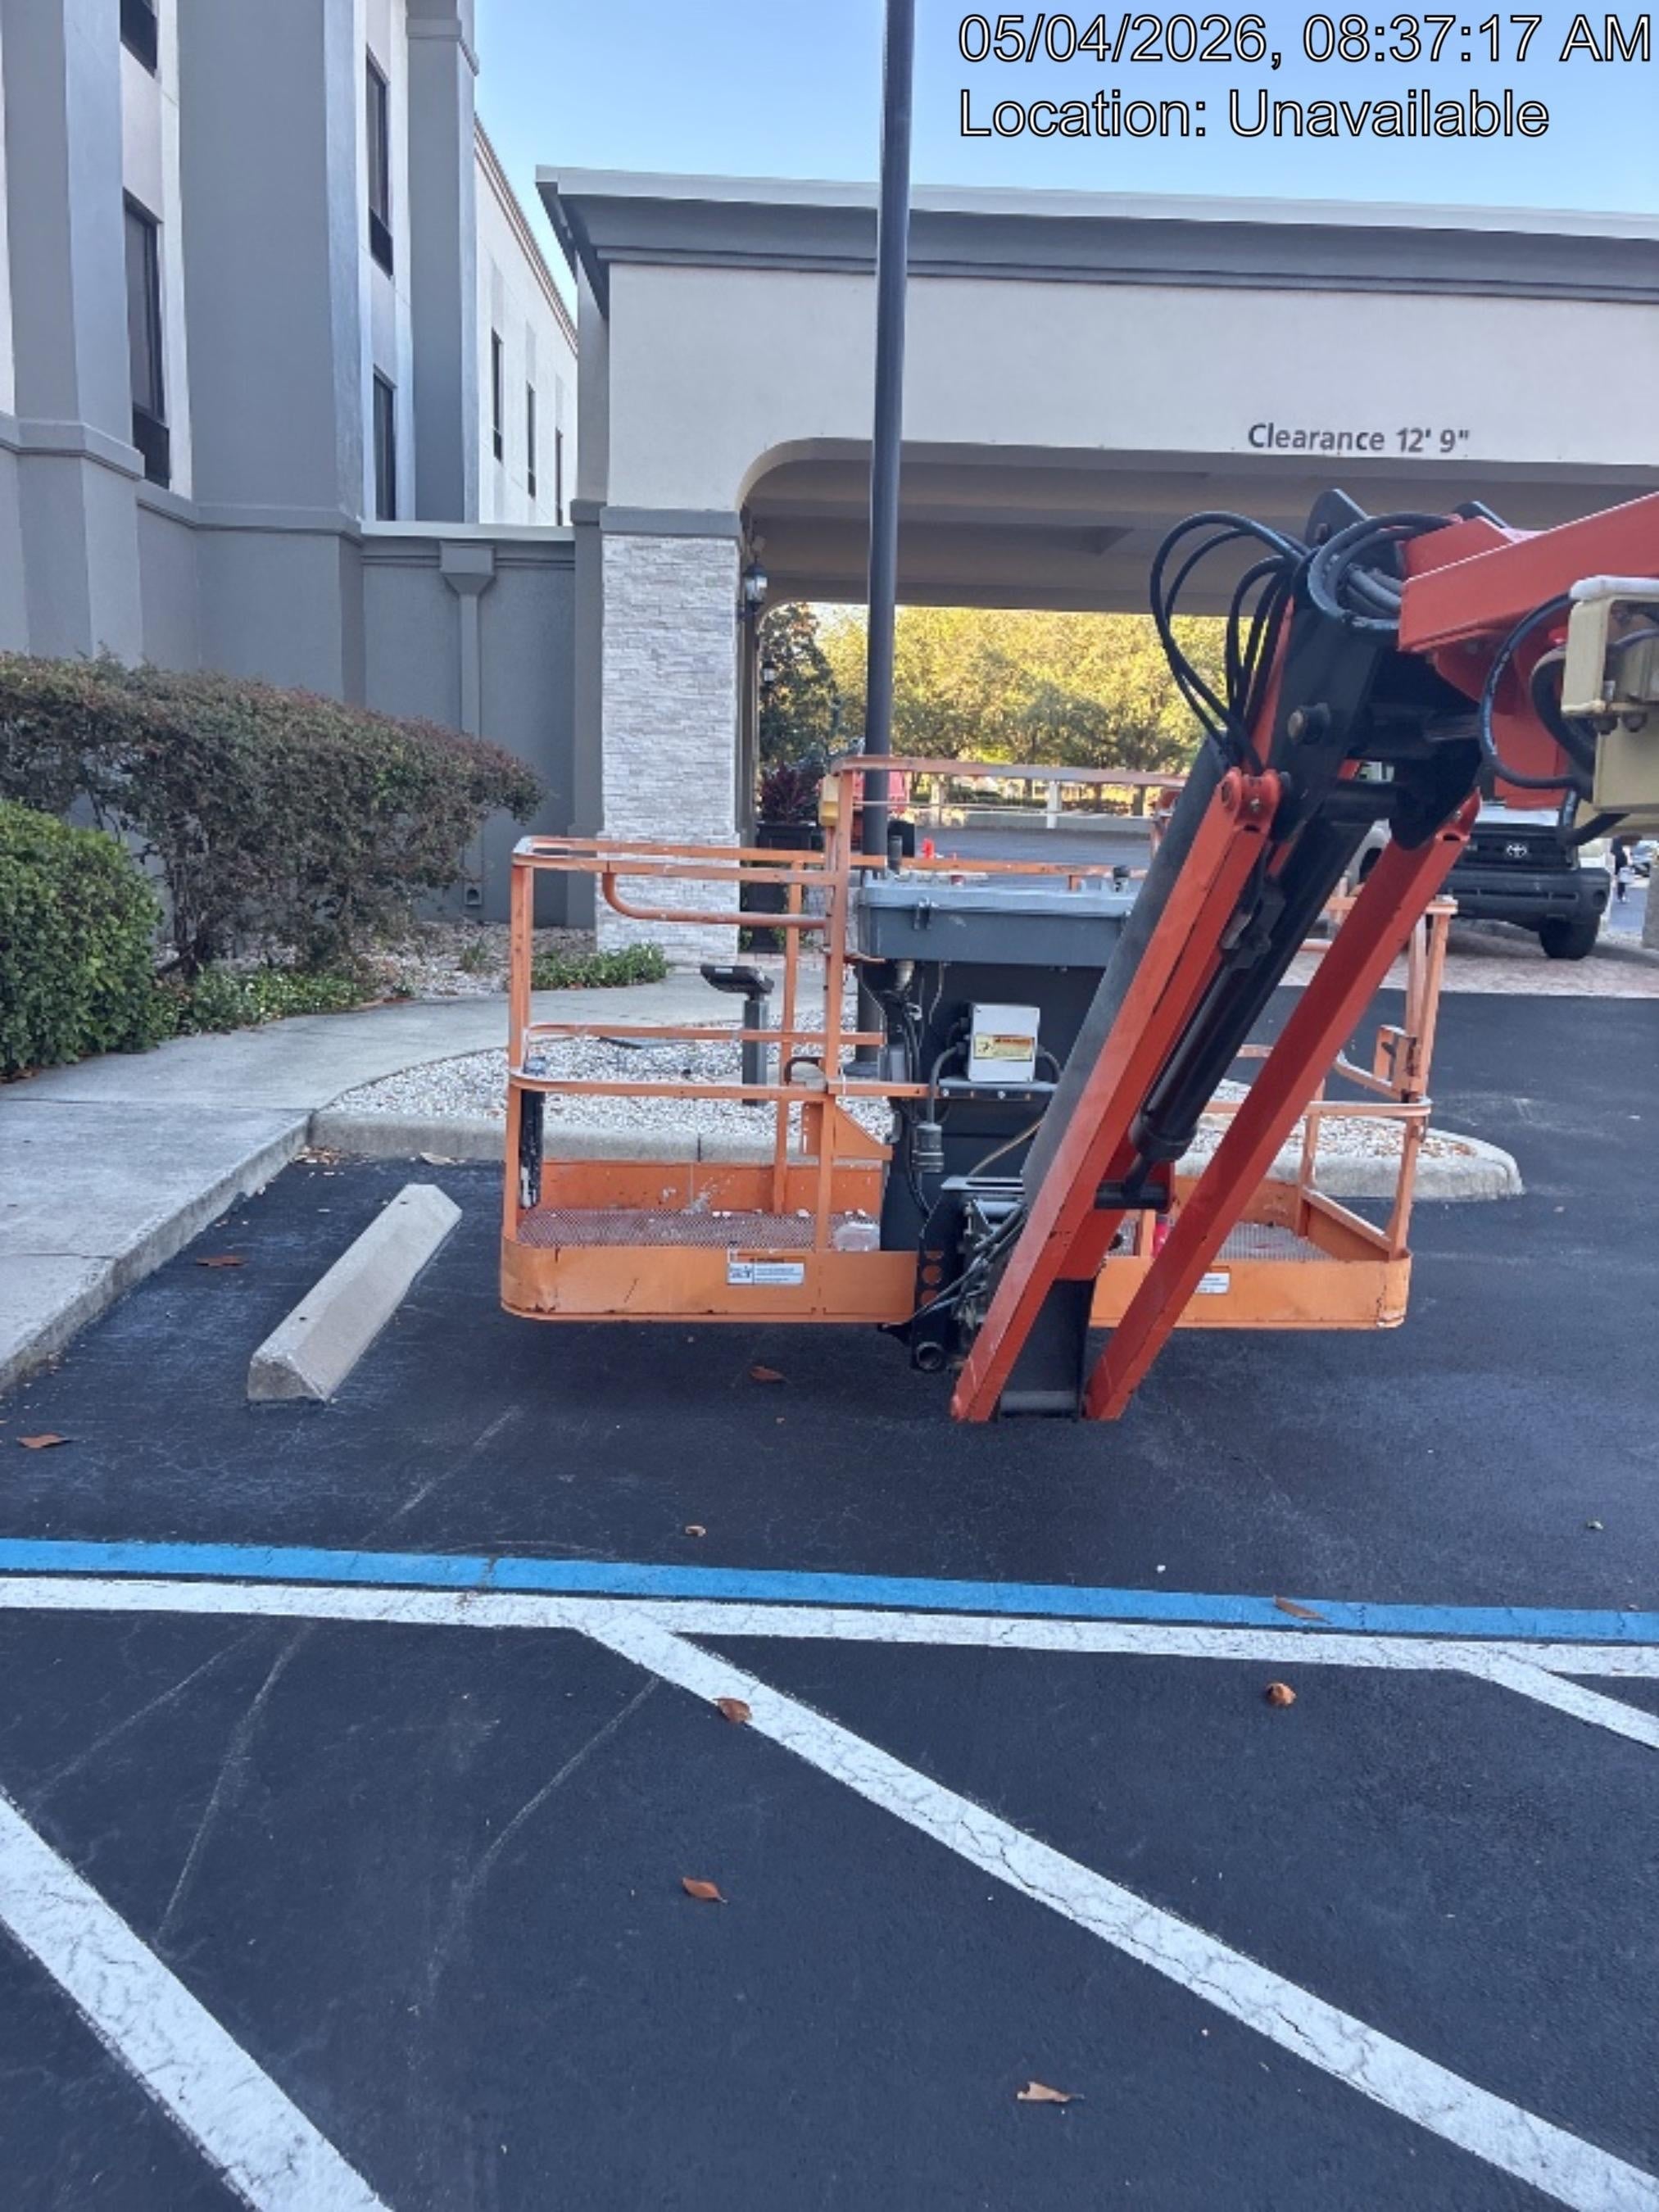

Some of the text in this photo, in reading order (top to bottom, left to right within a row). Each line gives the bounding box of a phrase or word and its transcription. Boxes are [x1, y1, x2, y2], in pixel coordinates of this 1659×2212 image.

[1248, 422, 1469, 452] Clearance 12' 9"
